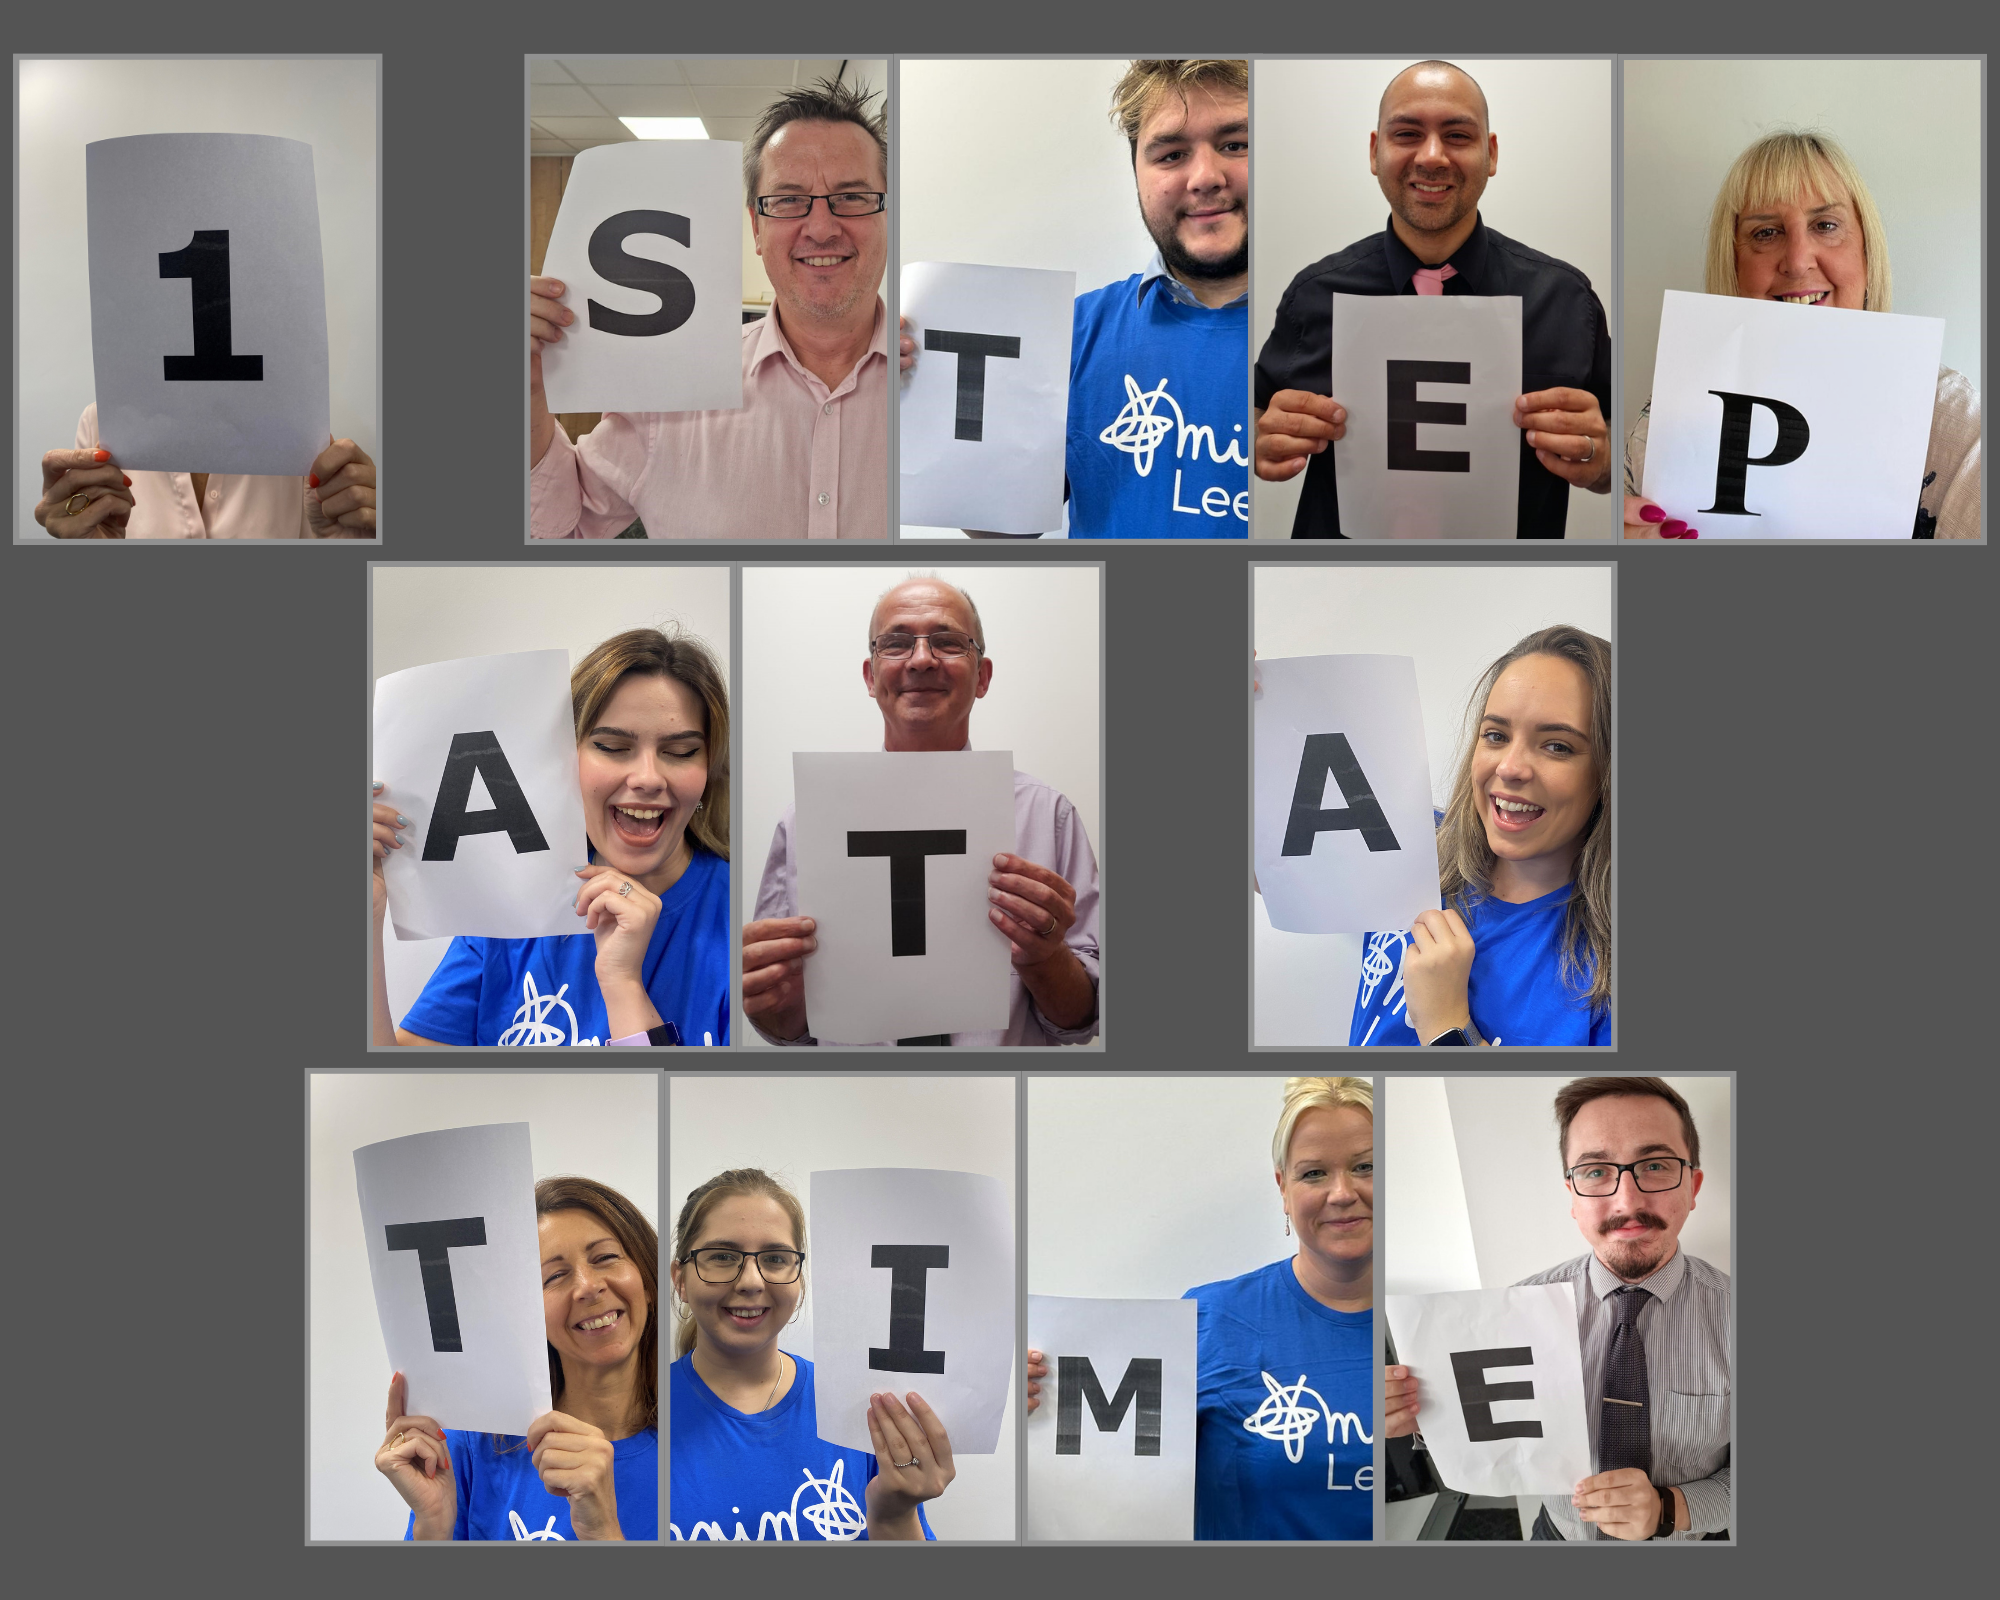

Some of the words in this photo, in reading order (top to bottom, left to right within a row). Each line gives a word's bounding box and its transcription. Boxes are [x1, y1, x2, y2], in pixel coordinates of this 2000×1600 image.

[157, 229, 264, 382] 1
[587, 209, 696, 337] S
[924, 330, 1021, 442] T
[1386, 360, 1471, 472] E
[1697, 390, 1810, 517] P
[421, 730, 550, 862] A
[1280, 732, 1402, 857] A
[846, 829, 967, 957] T
[384, 1216, 488, 1354] T
[867, 1244, 950, 1375] I
[1057, 1356, 1162, 1457] M
[1450, 1346, 1544, 1442] E
